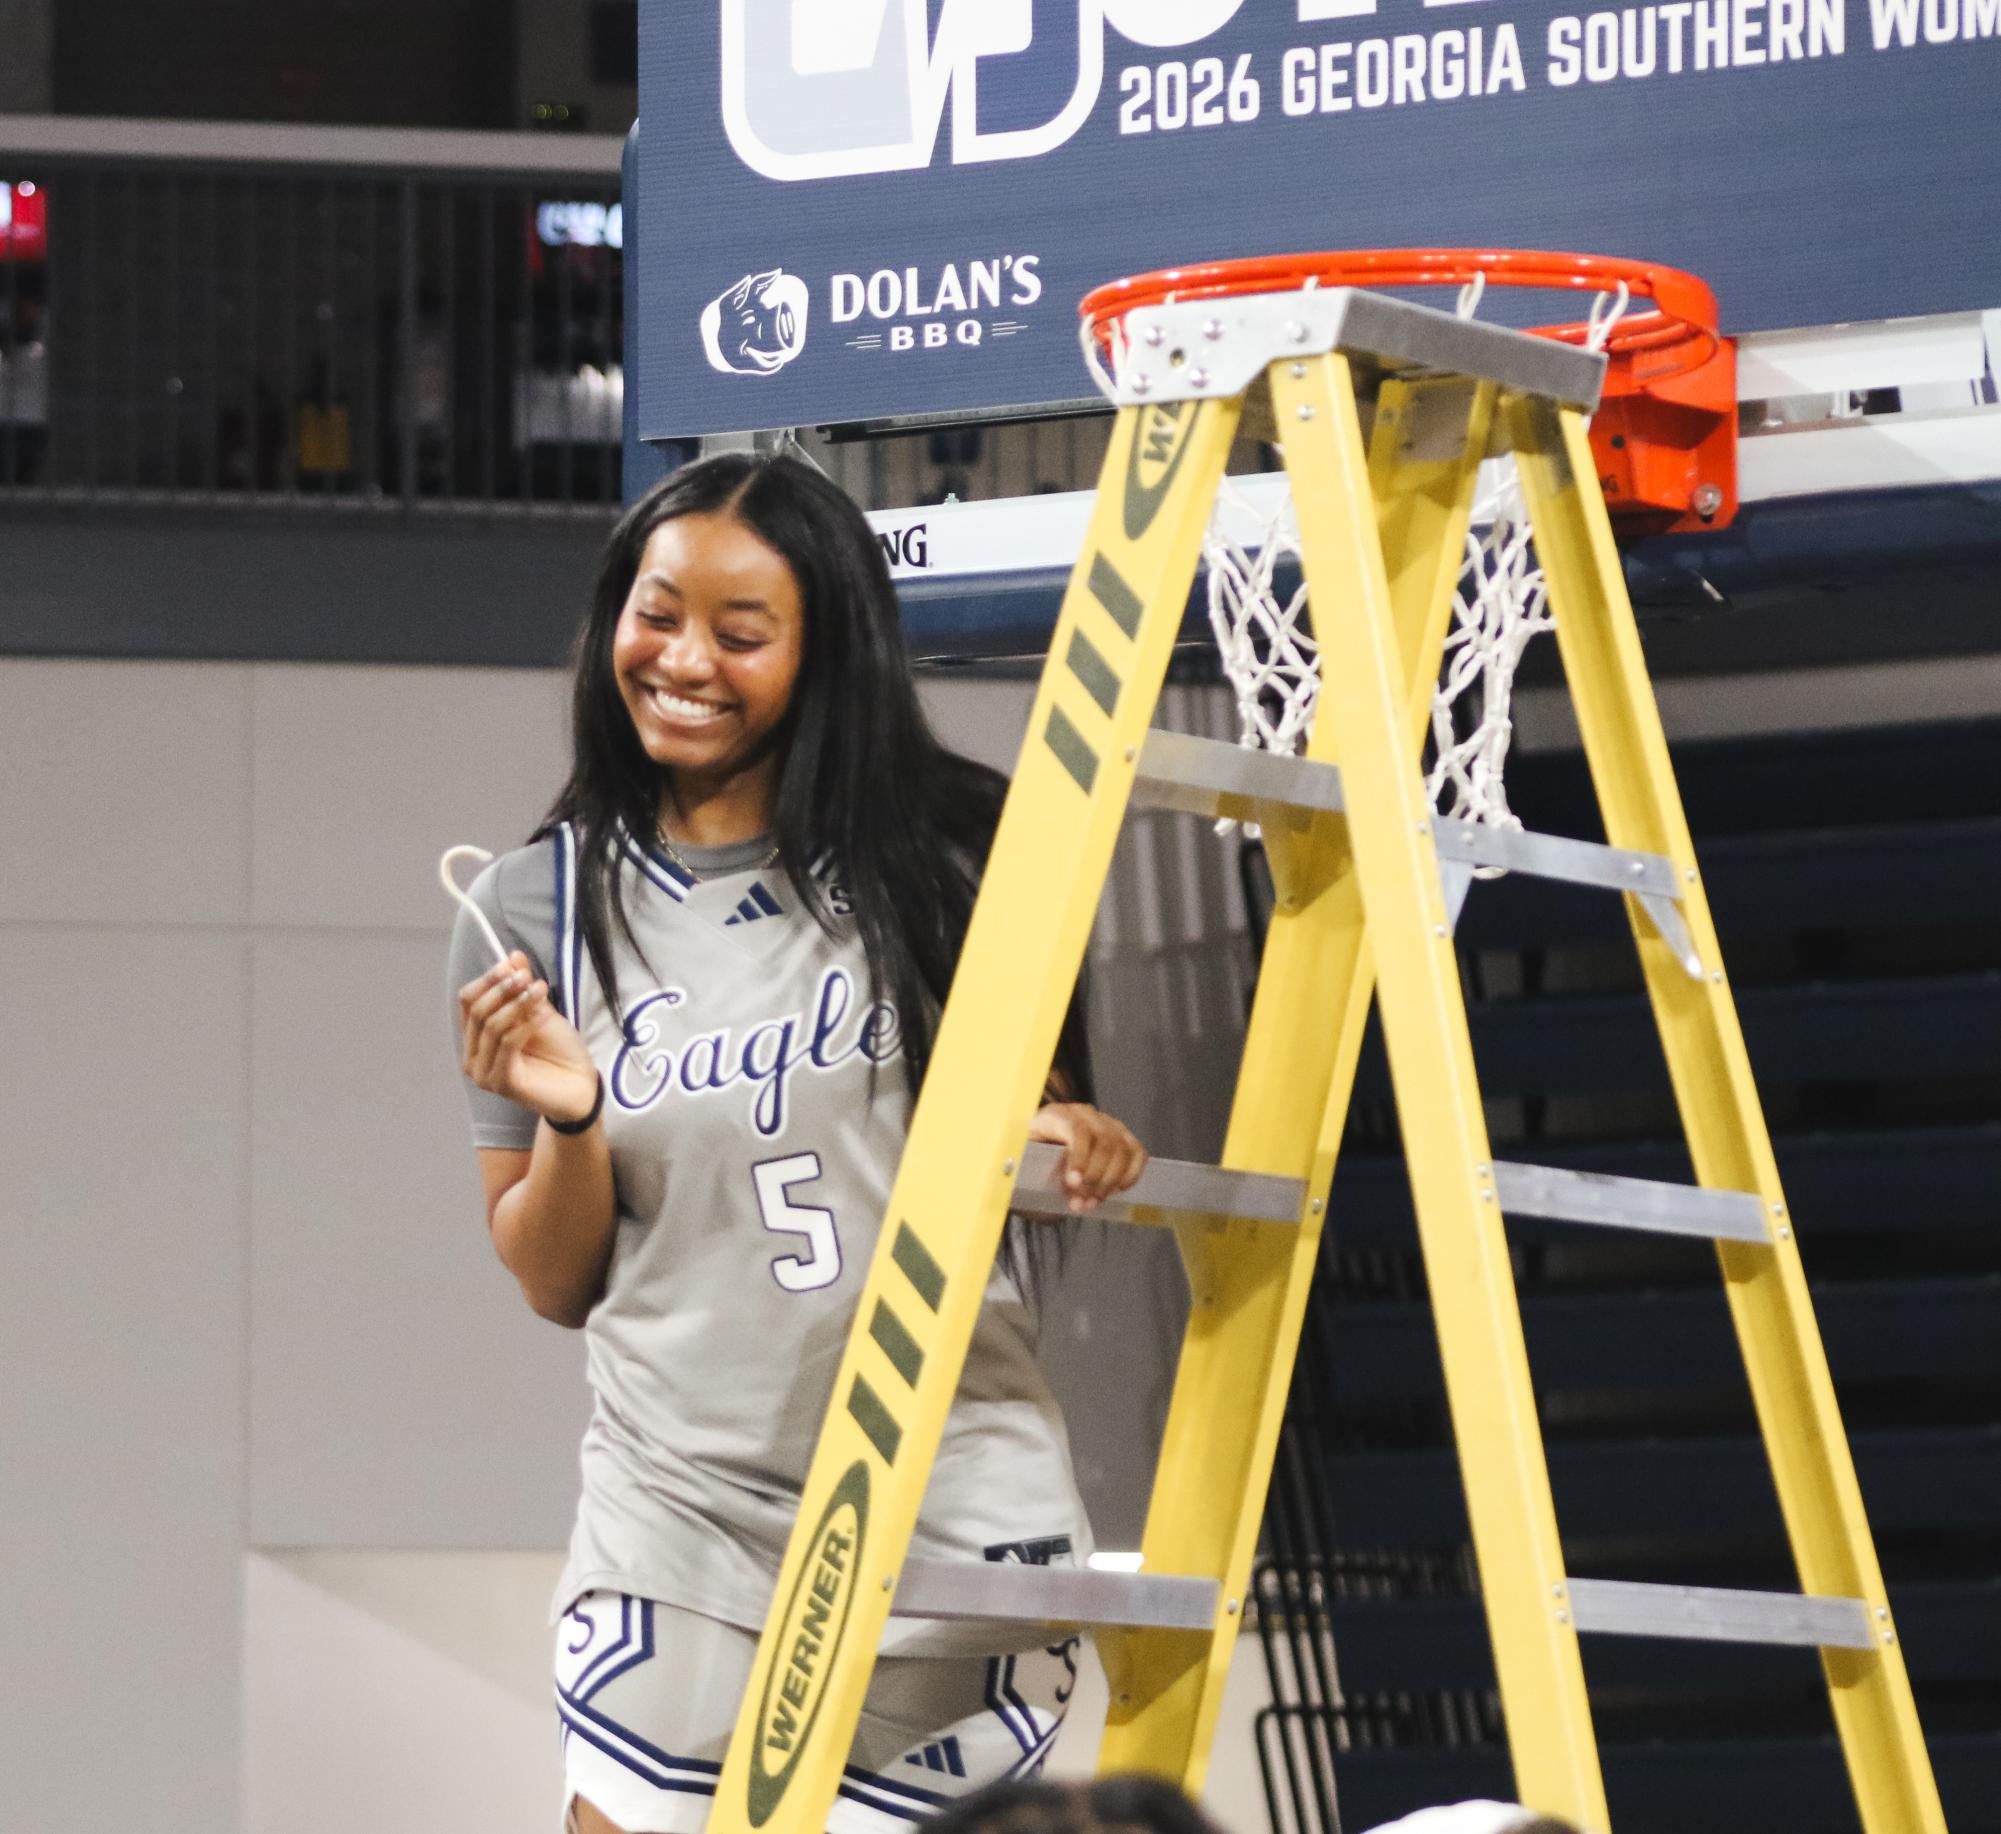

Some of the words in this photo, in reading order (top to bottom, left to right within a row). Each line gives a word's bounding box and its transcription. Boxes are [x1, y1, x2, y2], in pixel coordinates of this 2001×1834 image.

[1119, 53, 1261, 135] 2026
[1281, 23, 1526, 117] GEORGIA
[1547, 0, 1846, 88] SOUTHERN
[830, 253, 1042, 323] DOLAN'S
[890, 318, 983, 352] BBQ
[752, 1150, 842, 1292] 5
[766, 1527, 852, 1753] WERNER
